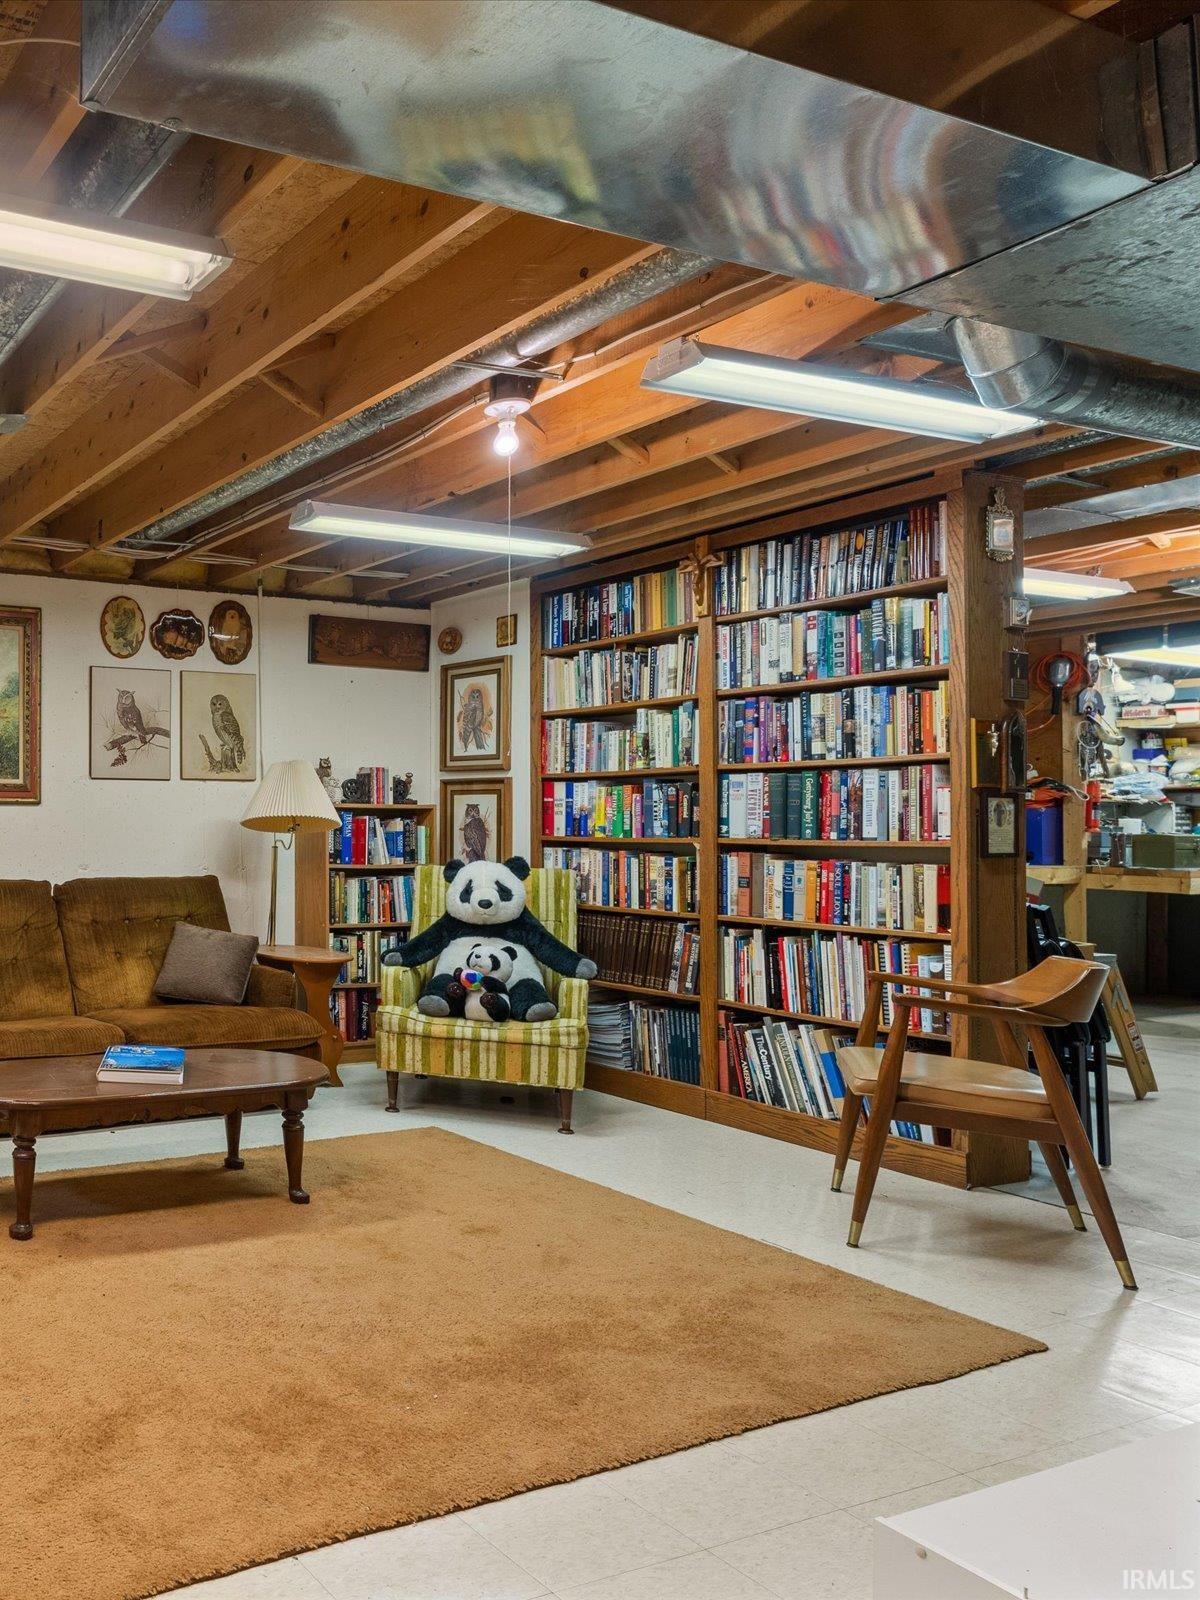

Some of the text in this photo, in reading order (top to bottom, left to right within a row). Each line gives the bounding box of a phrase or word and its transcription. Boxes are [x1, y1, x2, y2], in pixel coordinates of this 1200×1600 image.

[748, 788, 757, 821] VICTORY
[804, 778, 814, 810] Gettysburg
[804, 810, 814, 824] July
[688, 942, 697, 966] WESTERN
[741, 1059, 752, 1093] AMERICA
